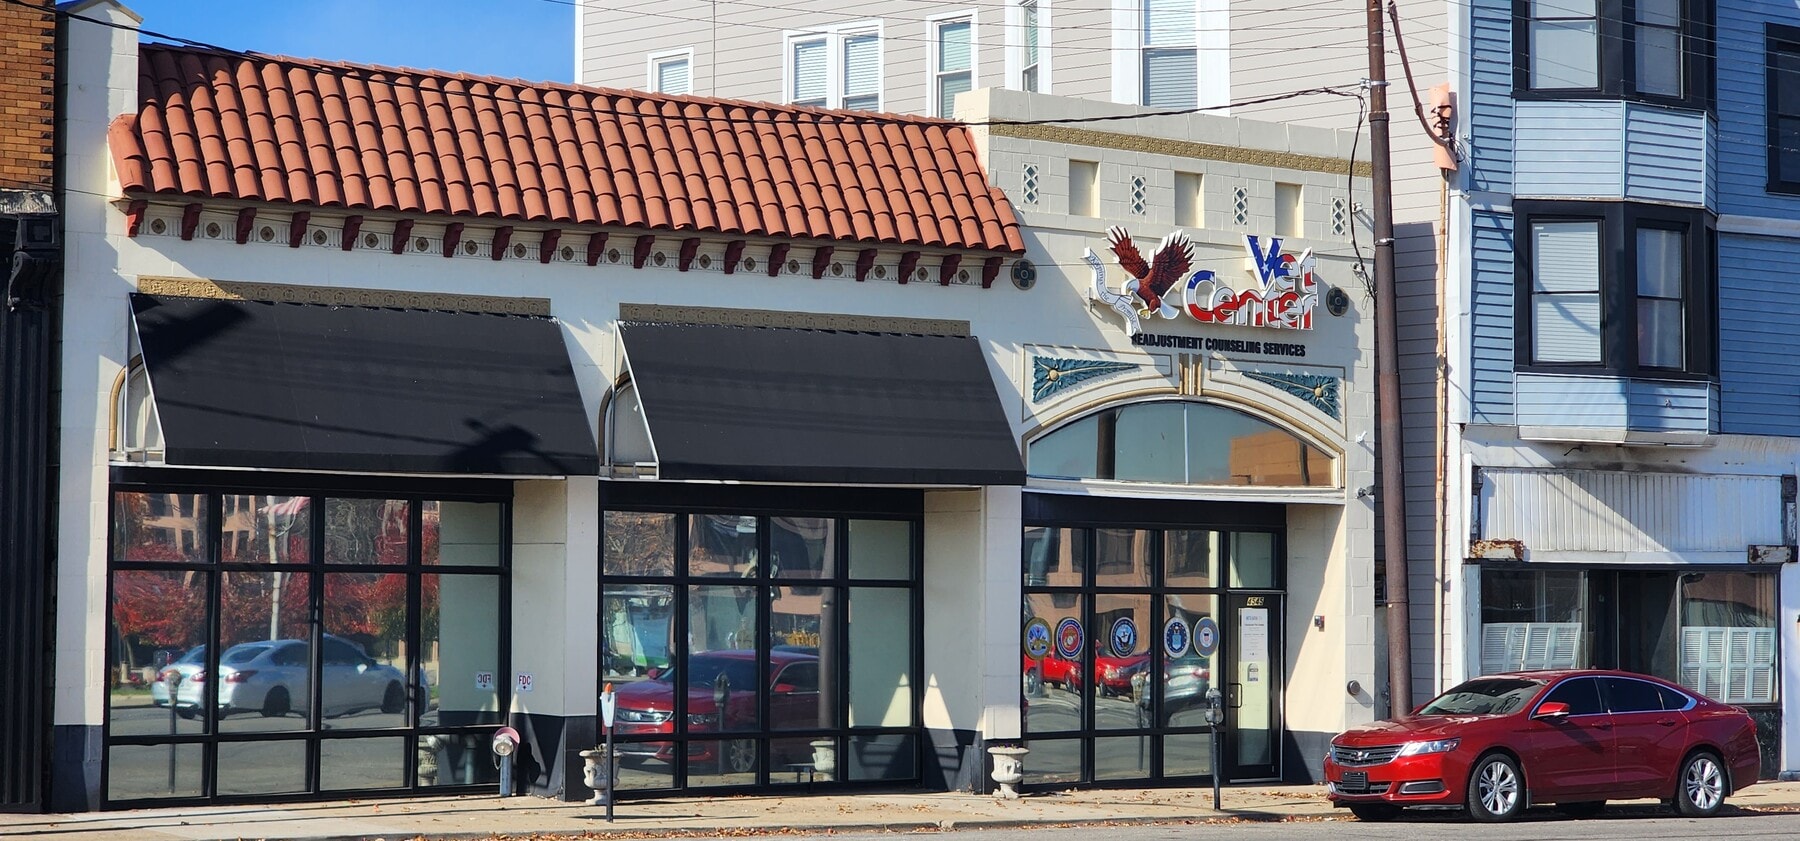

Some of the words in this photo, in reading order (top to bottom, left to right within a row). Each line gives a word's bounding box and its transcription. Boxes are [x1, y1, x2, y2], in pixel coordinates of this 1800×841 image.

[1243, 233, 1317, 295] Vet
[1183, 269, 1319, 331] Center
[1131, 333, 1203, 350] READJUSTMENT
[1205, 338, 1262, 354] COUNSELING
[1263, 342, 1306, 357] SERVICES
[1247, 597, 1264, 606] 4545
[518, 675, 531, 685] FDC
